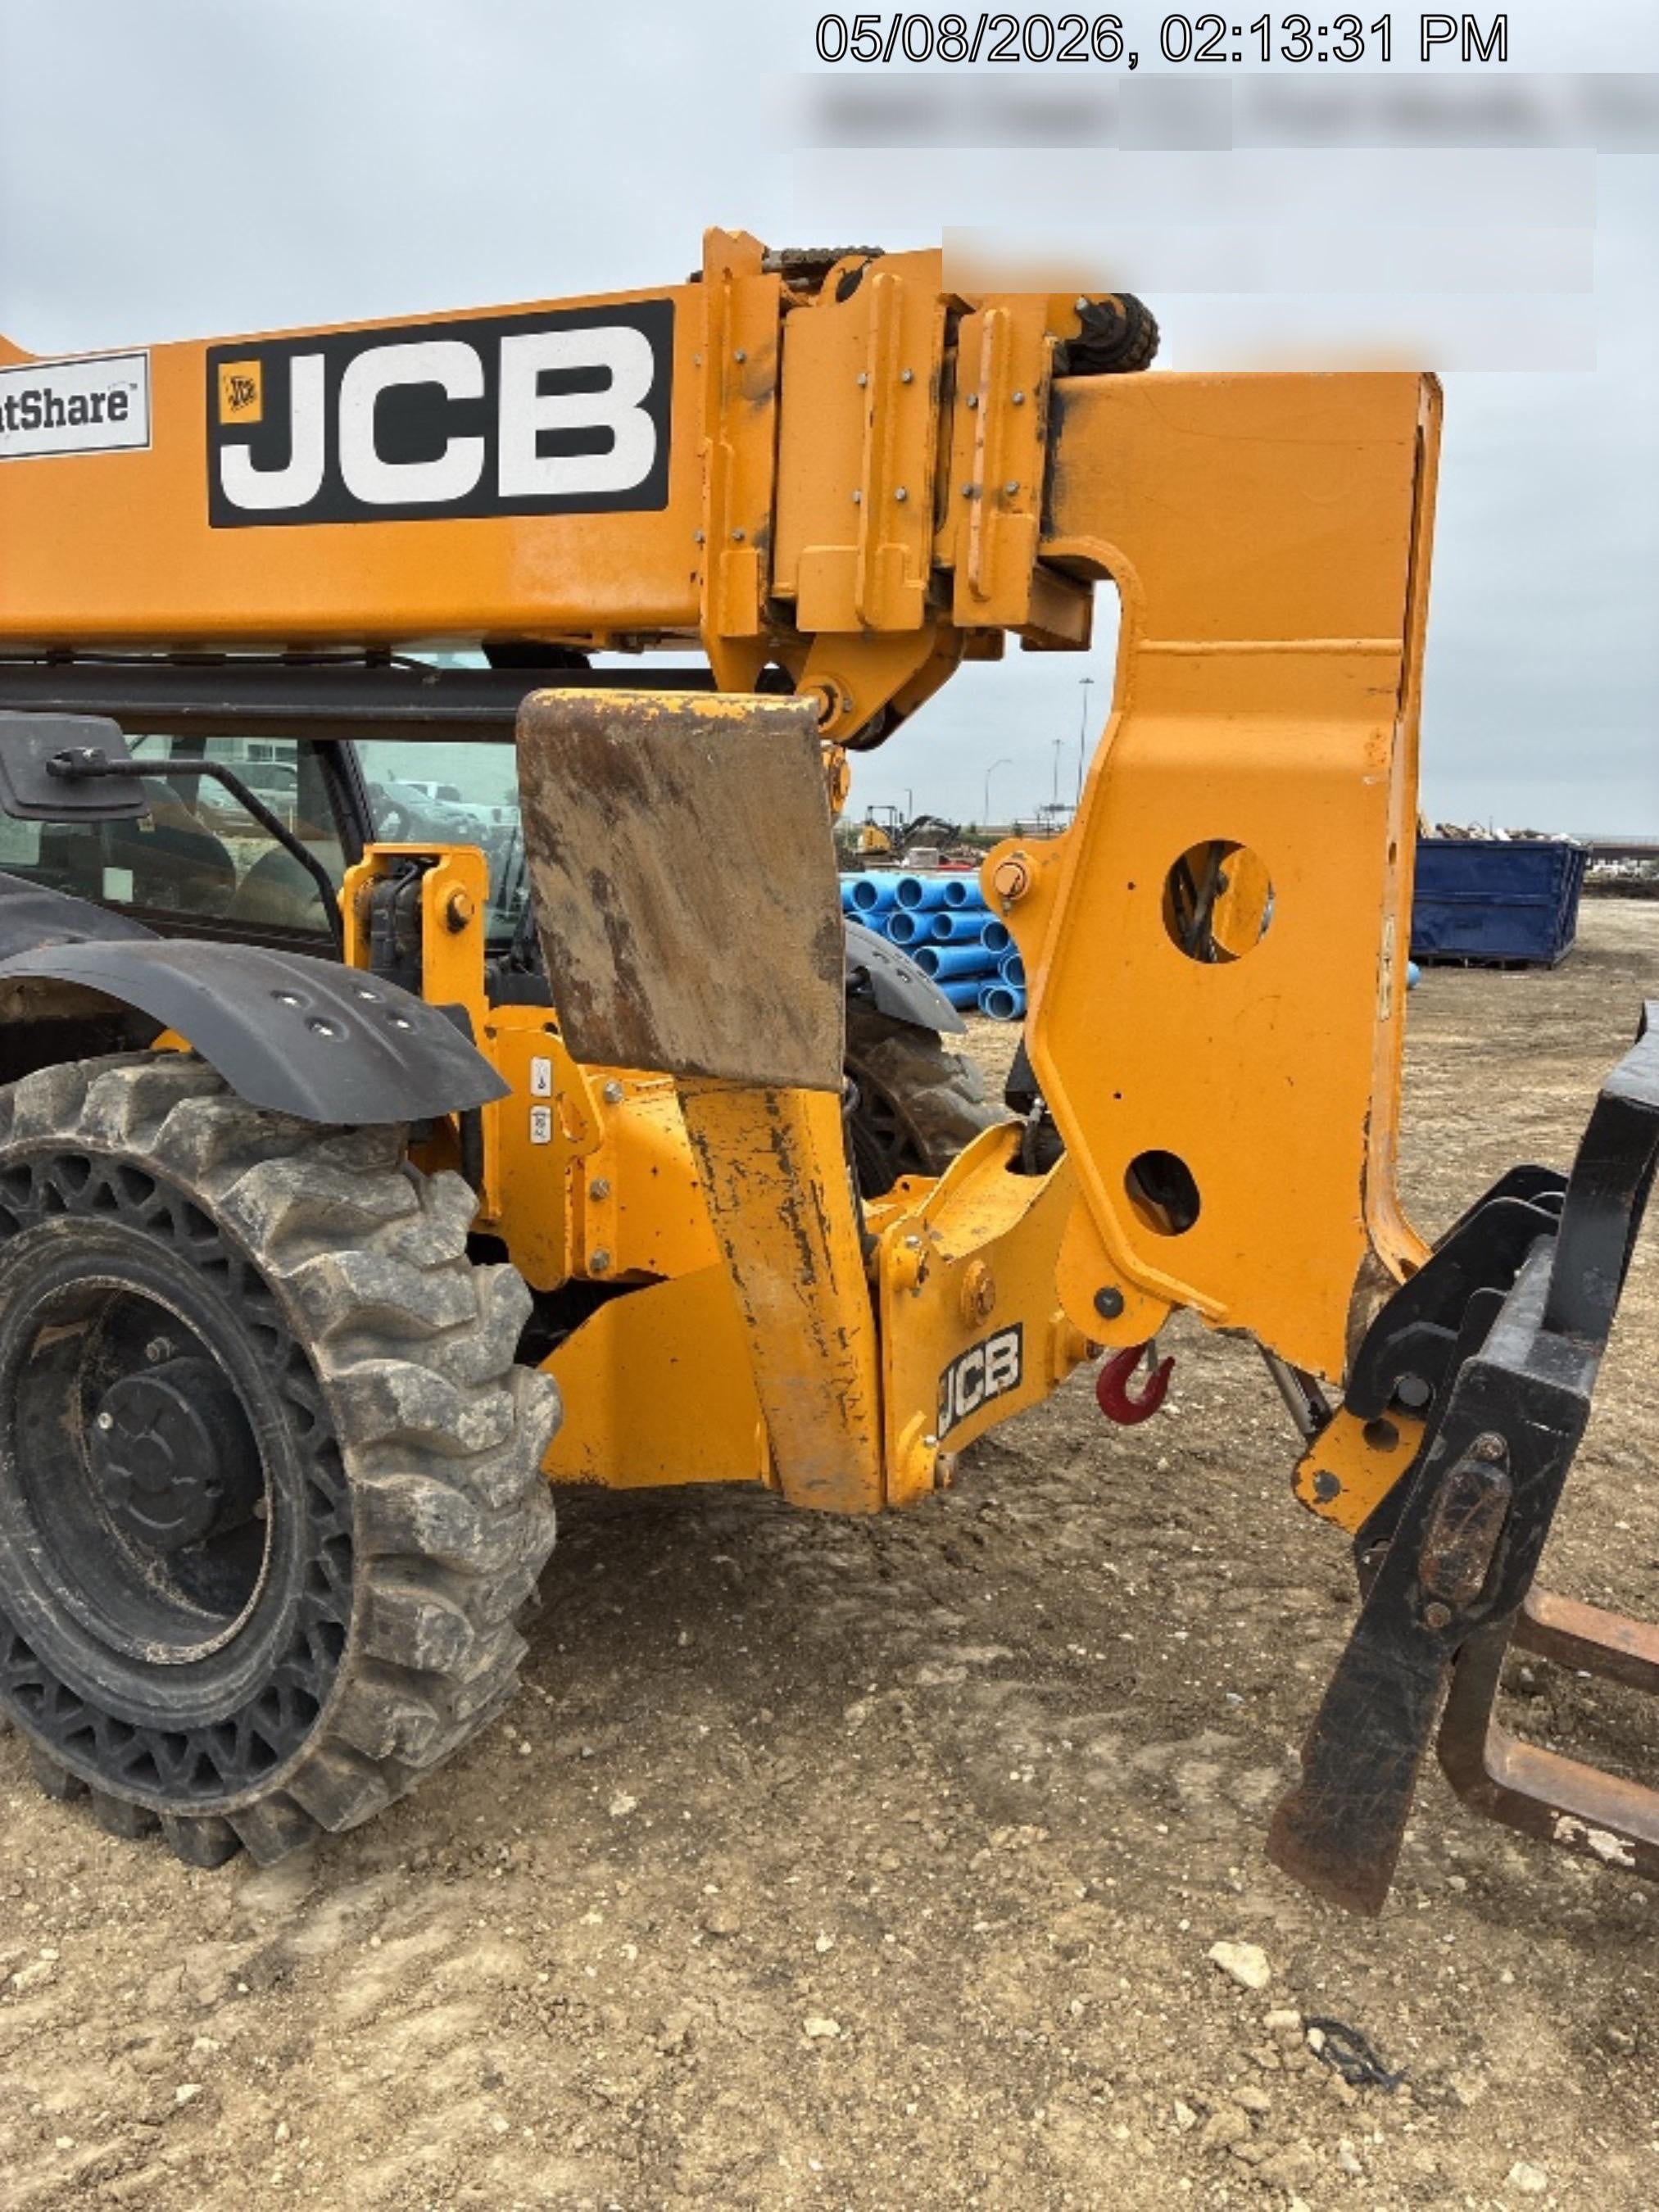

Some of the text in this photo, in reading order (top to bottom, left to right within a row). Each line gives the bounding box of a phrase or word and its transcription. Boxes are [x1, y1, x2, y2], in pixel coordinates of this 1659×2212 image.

[0, 388, 129, 433] tShare
[220, 325, 657, 510] JCB
[937, 1331, 1019, 1438] JCB
